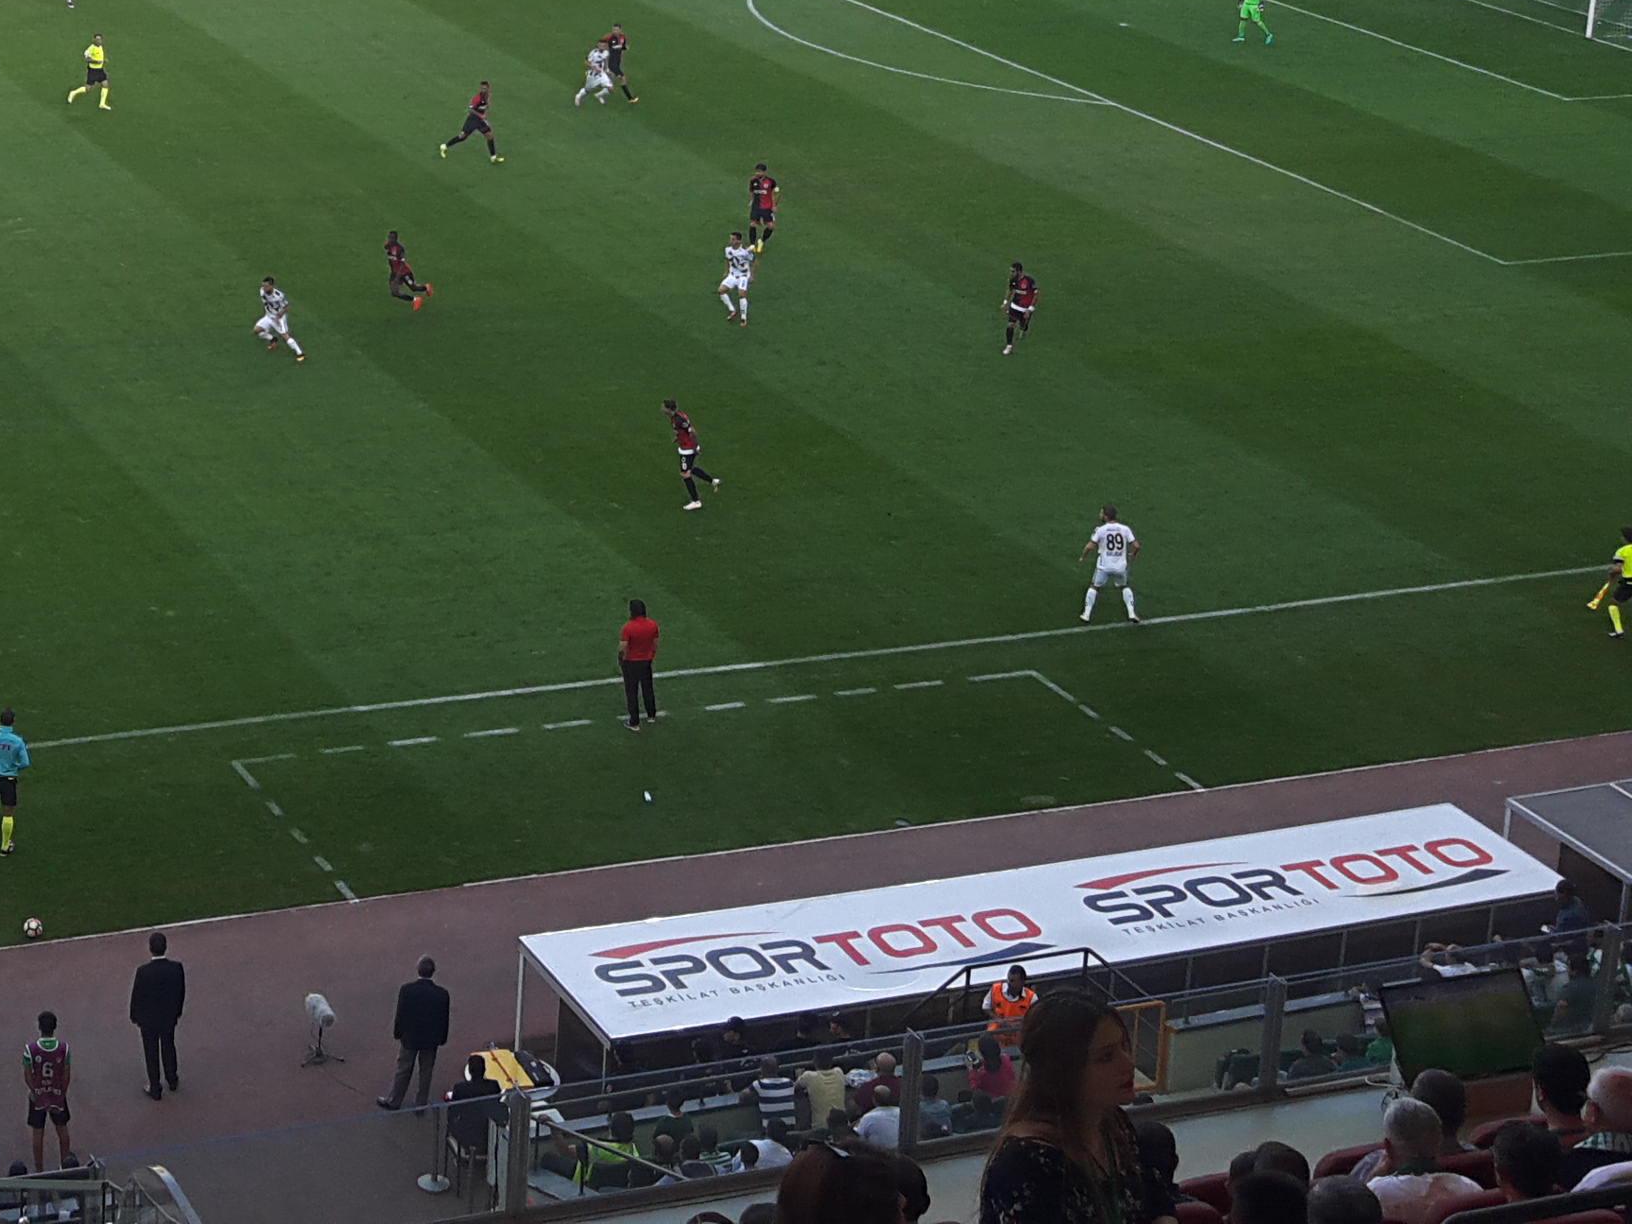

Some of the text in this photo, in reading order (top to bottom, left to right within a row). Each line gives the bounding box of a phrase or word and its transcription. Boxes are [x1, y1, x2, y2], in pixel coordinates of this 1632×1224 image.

[1106, 533, 1124, 551] 89
[1121, 897, 1320, 937] TEŞKİLAT BAŞKANLIĞI
[627, 973, 847, 1010] TEŞKİLAT BAŞKANLIĞI
[42, 1061, 54, 1078] 6
